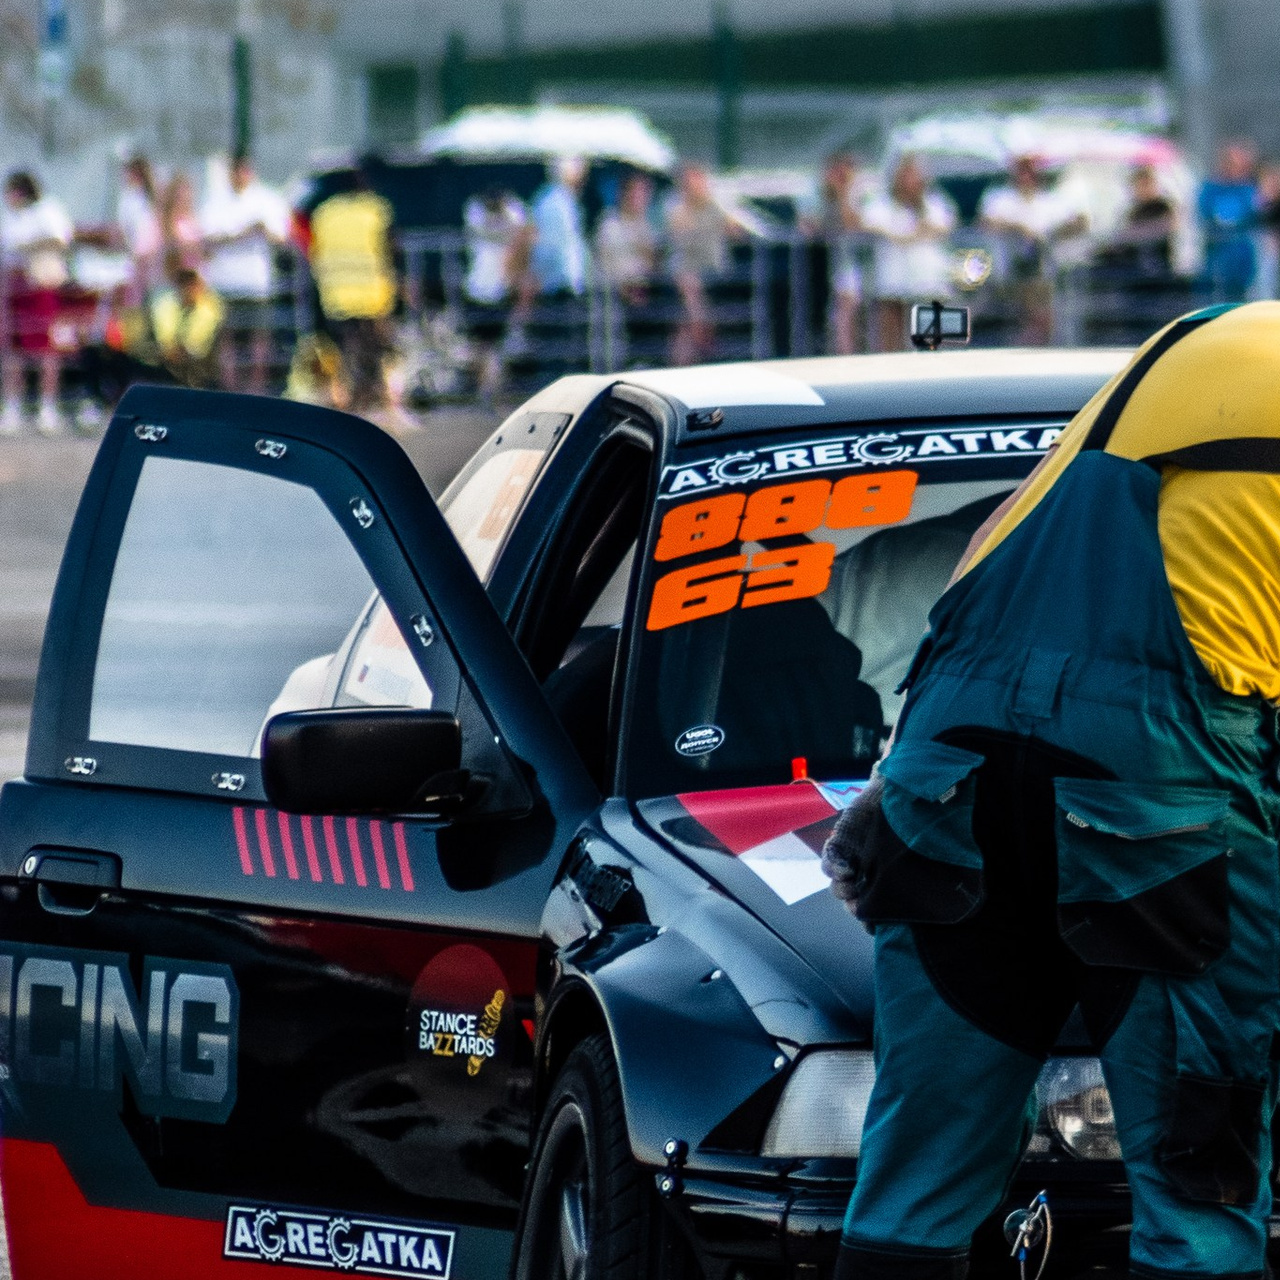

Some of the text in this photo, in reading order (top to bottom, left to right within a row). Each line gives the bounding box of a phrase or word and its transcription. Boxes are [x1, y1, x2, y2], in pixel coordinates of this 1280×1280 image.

[654, 470, 919, 561] 888
[646, 542, 836, 631] 63
[0, 954, 231, 1103] CING
[419, 1031, 495, 1058] BAZZTARDS
[420, 1009, 477, 1036] STANCE
[234, 1209, 443, 1271] AGREGATKA
